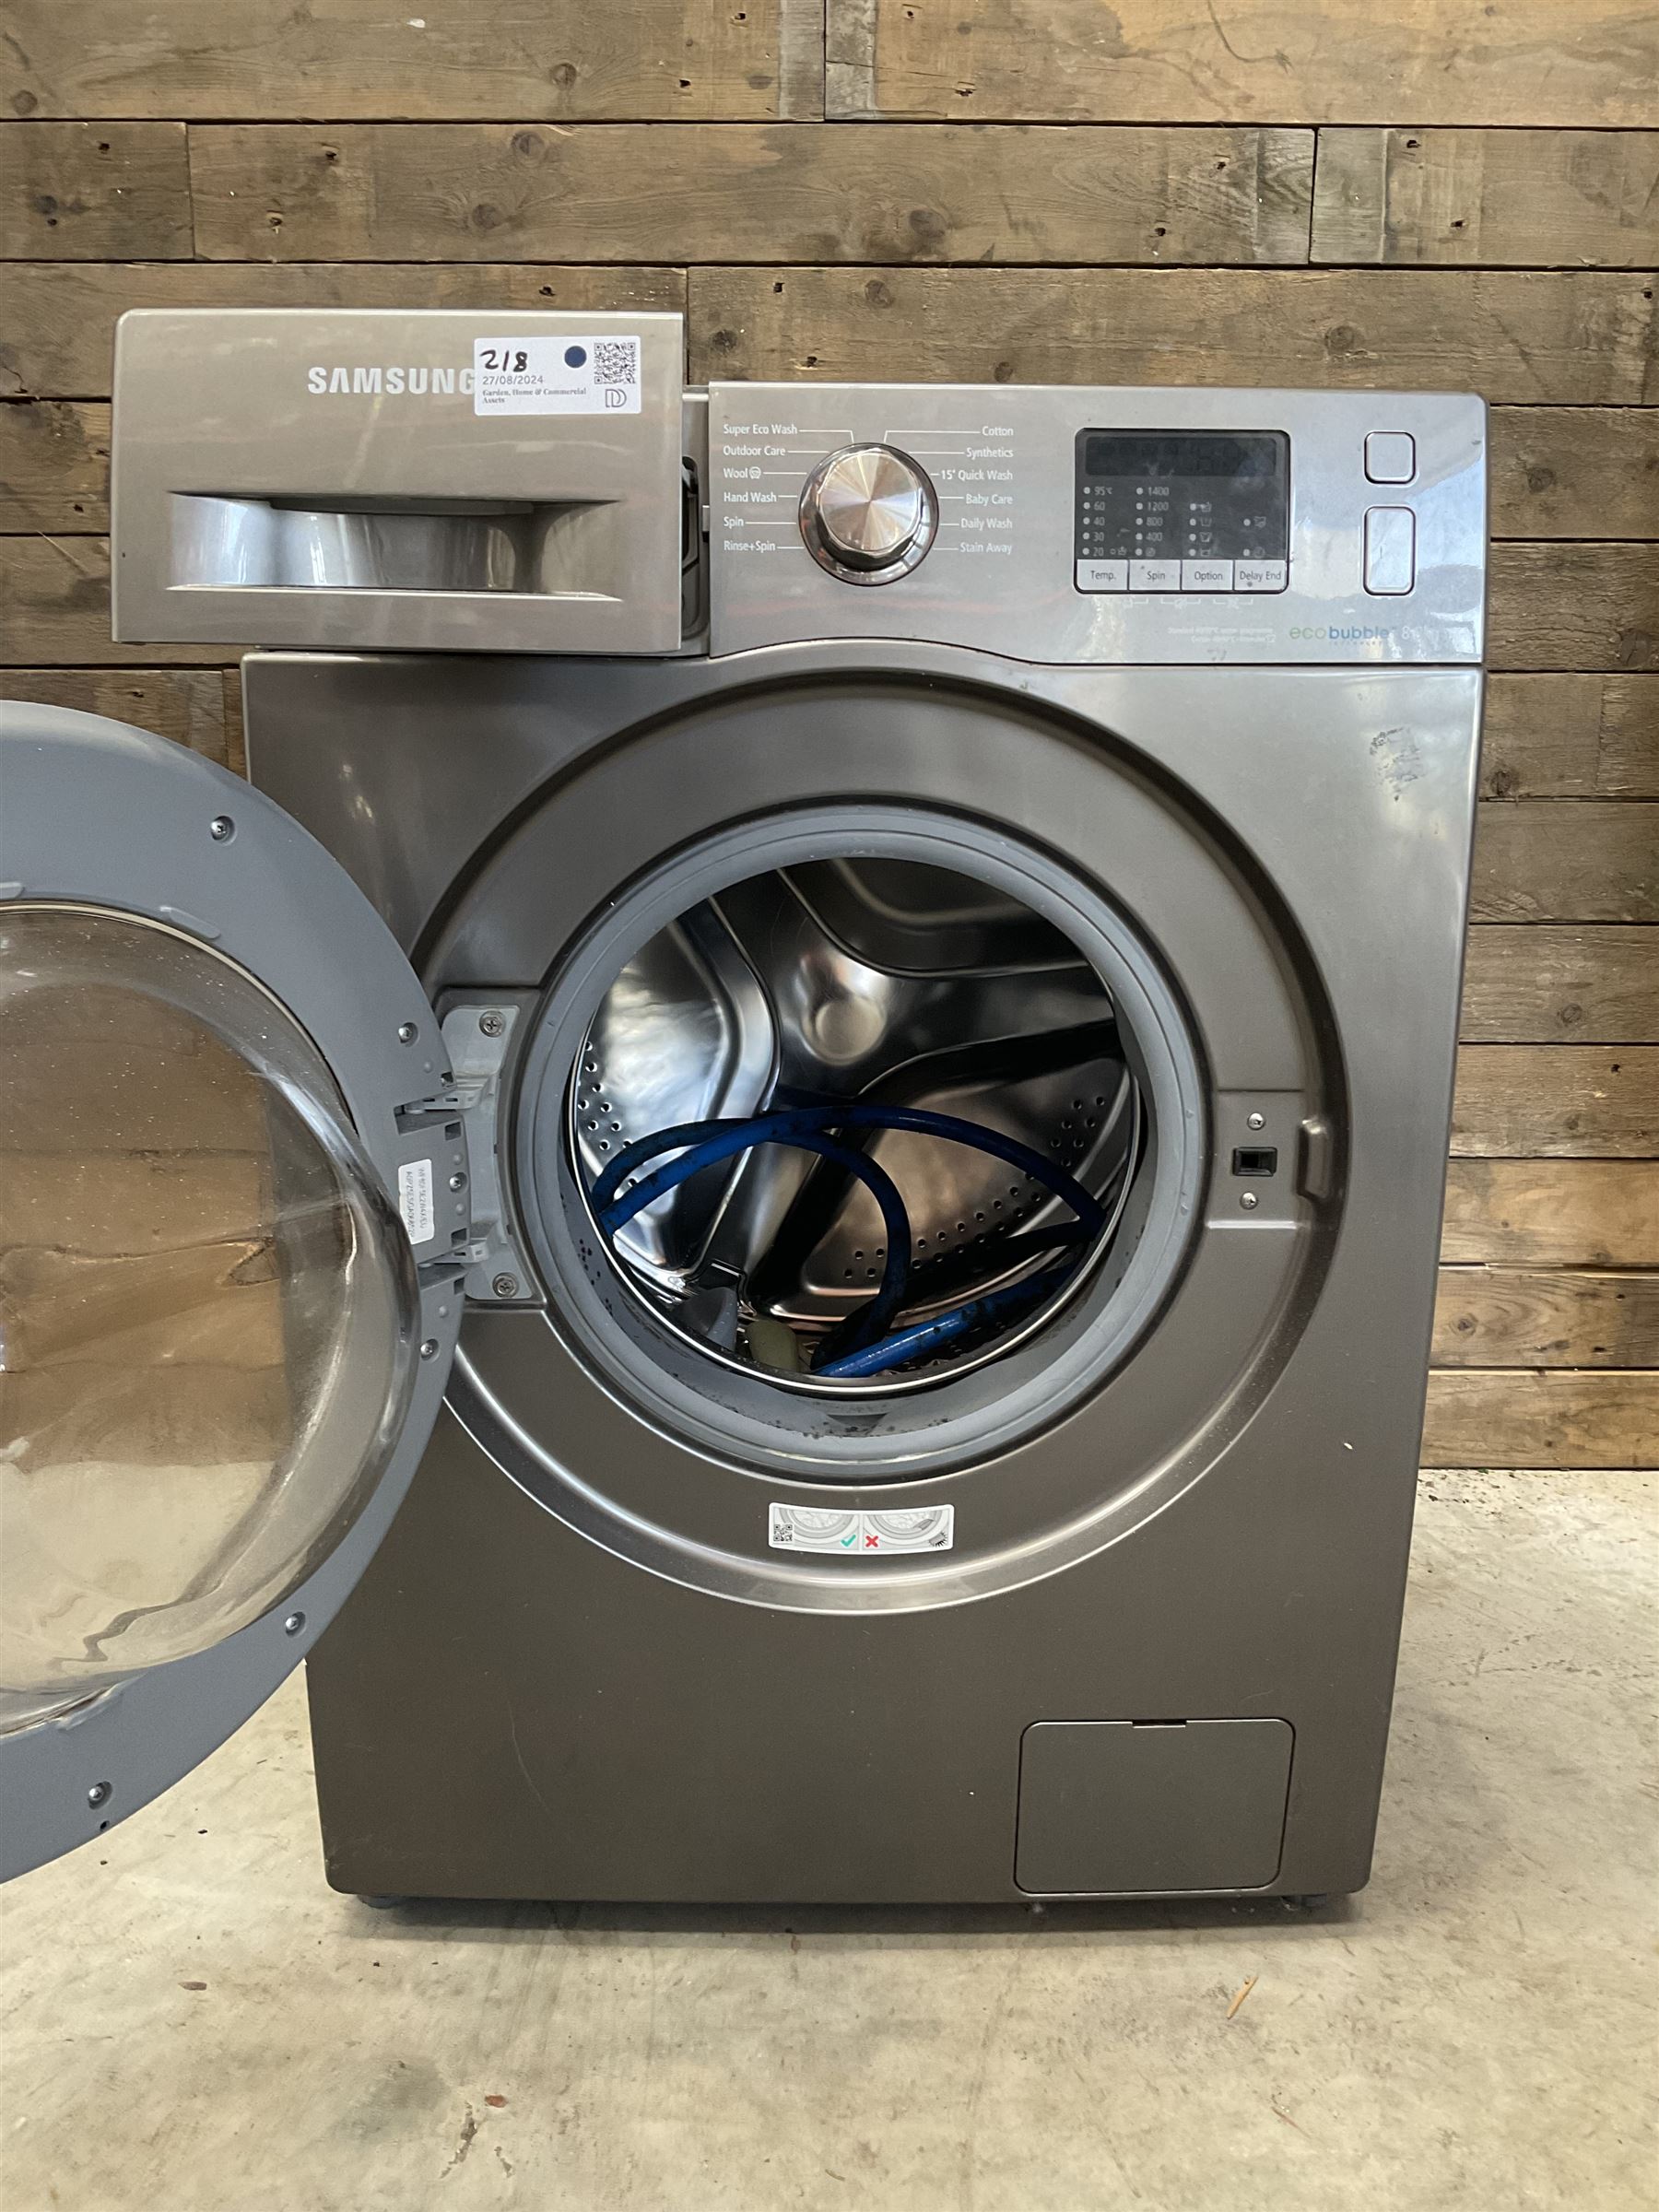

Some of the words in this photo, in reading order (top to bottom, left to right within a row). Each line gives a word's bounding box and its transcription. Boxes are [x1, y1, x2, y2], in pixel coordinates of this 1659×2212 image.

[479, 349, 528, 372] 218
[307, 367, 475, 394] SAMSUNG
[482, 375, 544, 385] 27/08/2024
[482, 389, 512, 397] Garden,
[543, 387, 587, 396] Commercial
[724, 424, 750, 436] Super
[753, 424, 769, 434] Eco
[771, 424, 798, 434] Wash
[982, 426, 1014, 436] Cotton
[724, 445, 761, 456] Outdoor
[764, 446, 786, 456] Care
[966, 447, 1014, 459] Synthetics
[724, 467, 748, 478] Wool
[958, 469, 984, 481] Quick
[987, 469, 1013, 480] Wash
[1147, 487, 1170, 496] 1400
[724, 492, 748, 503] Hand
[750, 492, 777, 503] Wash
[966, 493, 989, 506] Baby
[992, 494, 1014, 504] Care
[1094, 500, 1106, 511] 60
[1147, 501, 1170, 512] 1200
[724, 516, 744, 529] Spin
[961, 518, 985, 531] Daily
[987, 518, 1013, 530] Wash
[1093, 516, 1105, 526] 40
[1146, 517, 1163, 527] 800
[1092, 531, 1105, 542] 30
[1146, 532, 1163, 542] 400
[724, 540, 776, 553] Rinse+Spin
[960, 542, 984, 553] Stain
[986, 543, 1012, 556] Away
[1090, 571, 1117, 582] Temp.
[1147, 571, 1166, 583] Spin
[1194, 571, 1223, 583] Option
[1239, 571, 1264, 583] Delay
[1265, 571, 1282, 581] End
